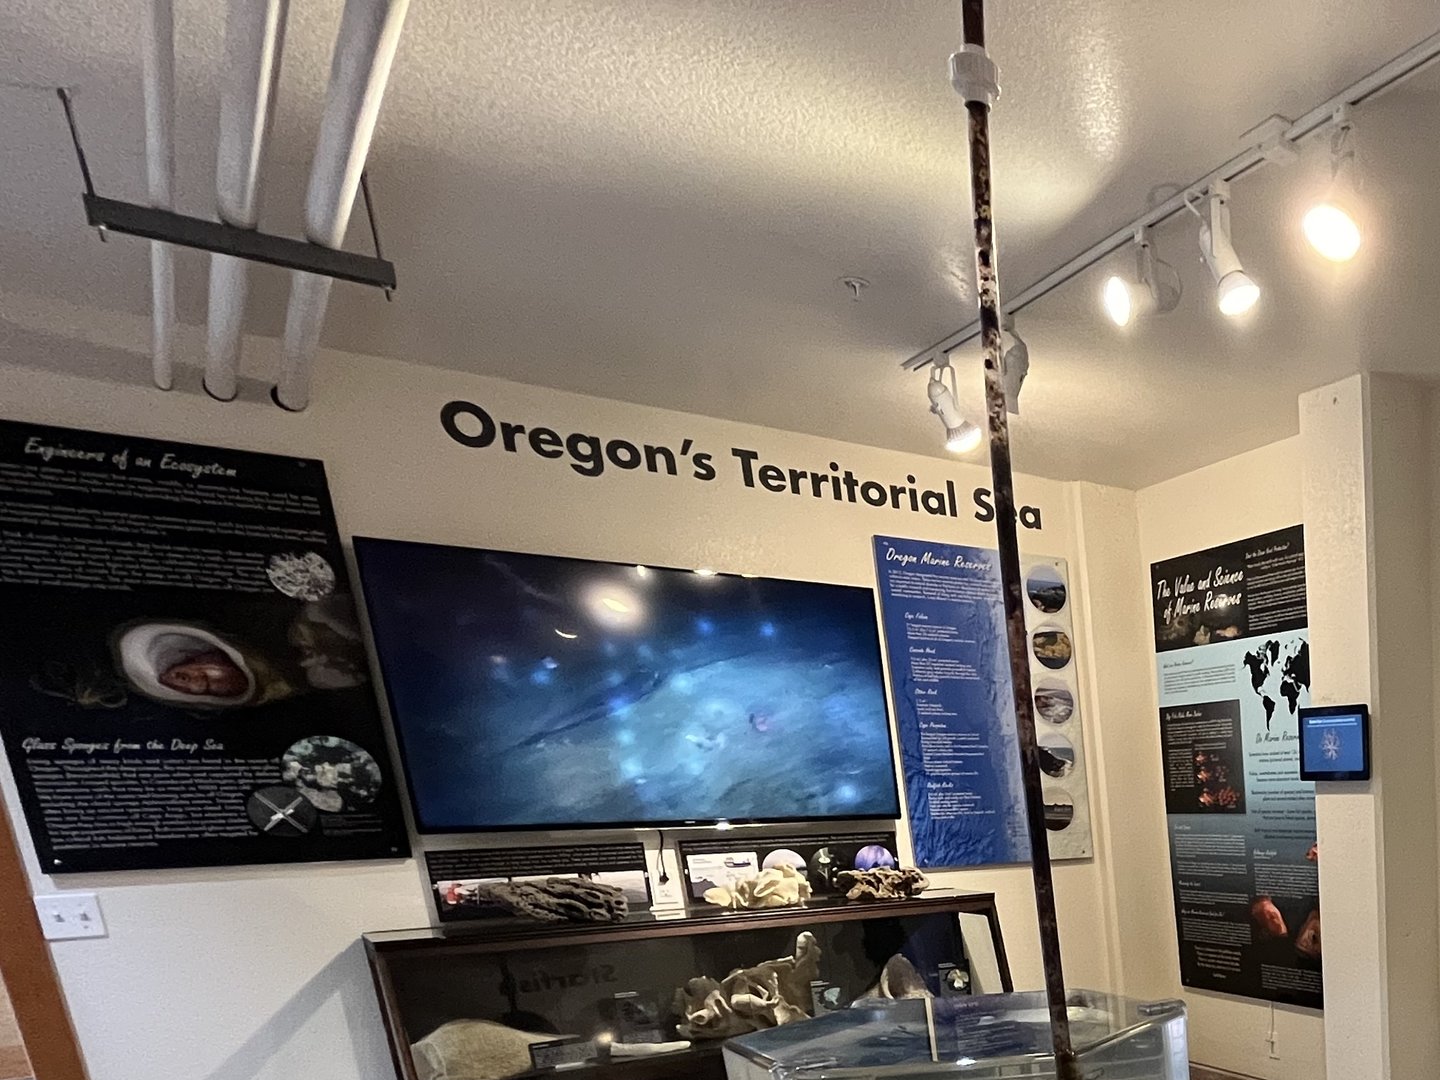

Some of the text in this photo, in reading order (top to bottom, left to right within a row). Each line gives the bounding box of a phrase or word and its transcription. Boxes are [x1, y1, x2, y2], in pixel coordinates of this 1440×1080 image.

[111, 448, 129, 470] of
[135, 456, 151, 468] an
[159, 452, 237, 479] Ecosystem
[440, 401, 1042, 530] Oregon's Territorial Sa
[886, 547, 917, 566] Oregon
[920, 551, 951, 567] Marine
[1156, 564, 1245, 601] The Value and Science
[1163, 599, 1174, 625] of
[1173, 594, 1201, 618] Marine
[22, 737, 225, 755] Glass Sponges from the Deep Sea
